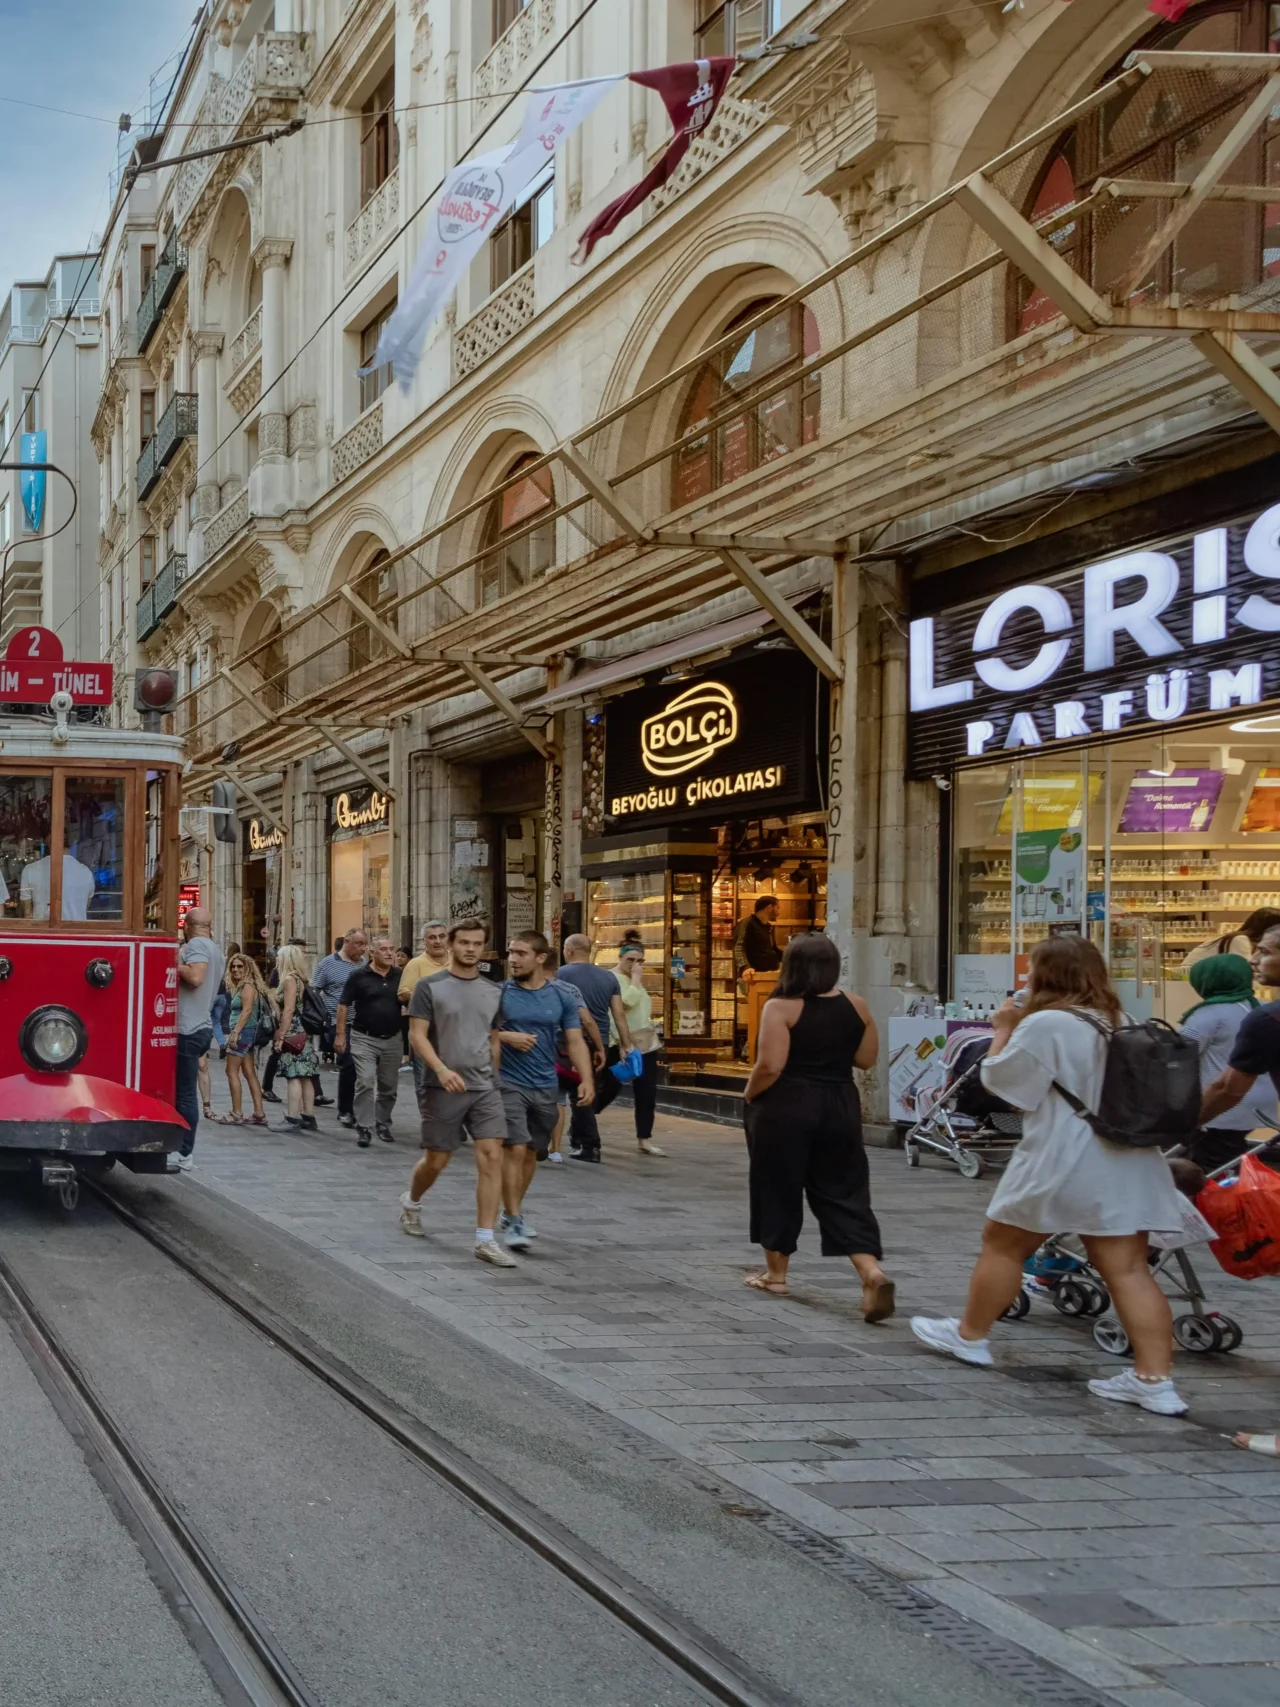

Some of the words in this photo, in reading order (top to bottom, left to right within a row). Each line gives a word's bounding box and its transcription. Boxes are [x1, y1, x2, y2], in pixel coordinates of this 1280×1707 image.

[27, 630, 41, 657] 2
[52, 667, 104, 695] TÜNEL
[966, 663, 1263, 756] PARFÜM
[612, 786, 677, 816] BEYOĞLU
[685, 765, 782, 806] ÇİKOLATASI
[336, 791, 388, 828] Bambi
